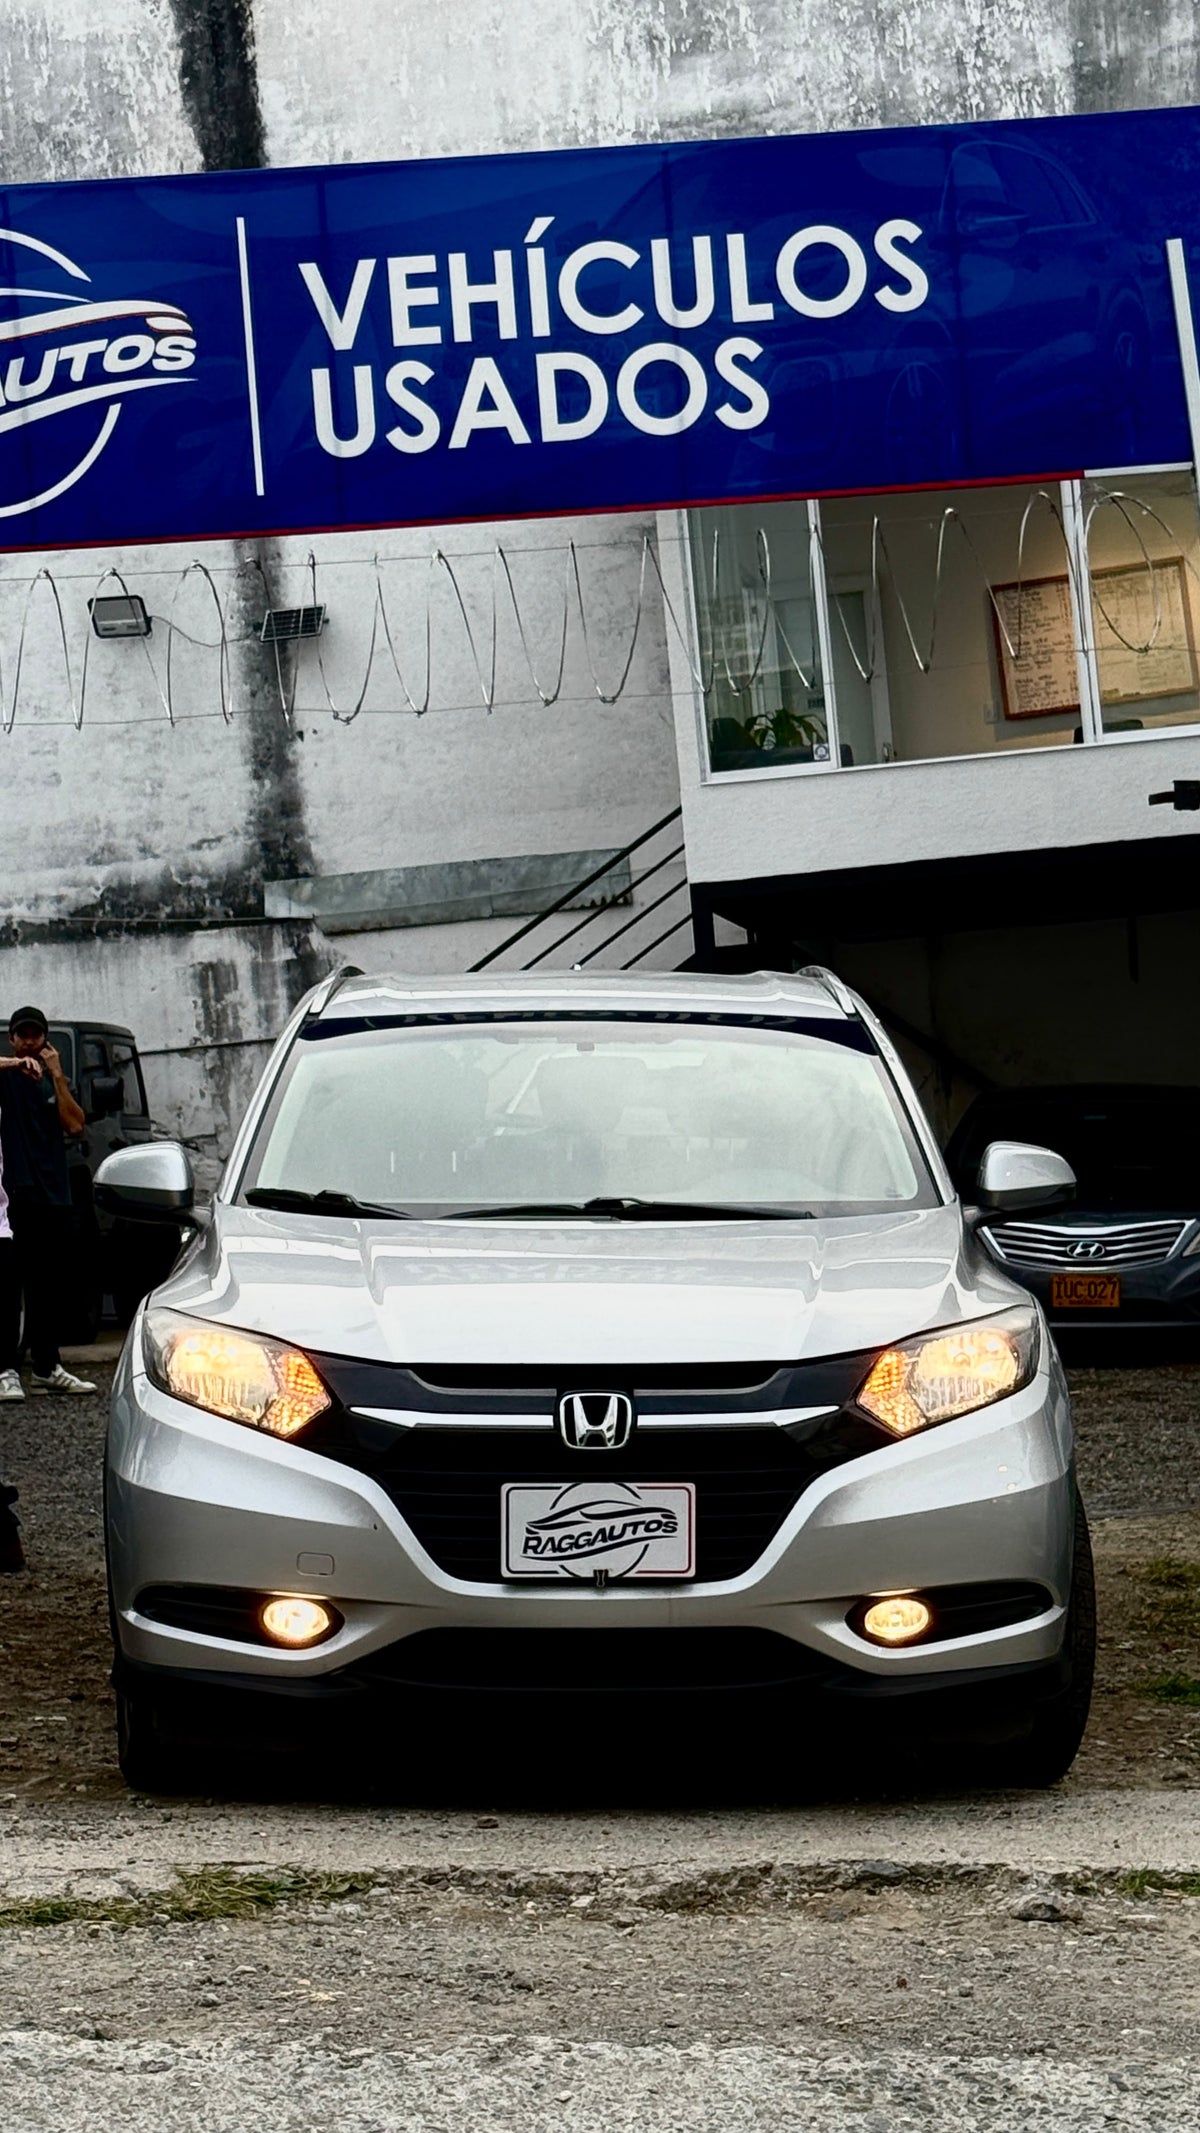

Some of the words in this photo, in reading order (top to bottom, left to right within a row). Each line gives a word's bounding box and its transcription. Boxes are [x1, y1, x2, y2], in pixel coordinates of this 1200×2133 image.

[298, 216, 929, 351] VEHÍCULOS
[0, 334, 197, 408] UTOS
[311, 336, 770, 459] USADOS
[522, 1519, 679, 1555] RAGGAUTOS
